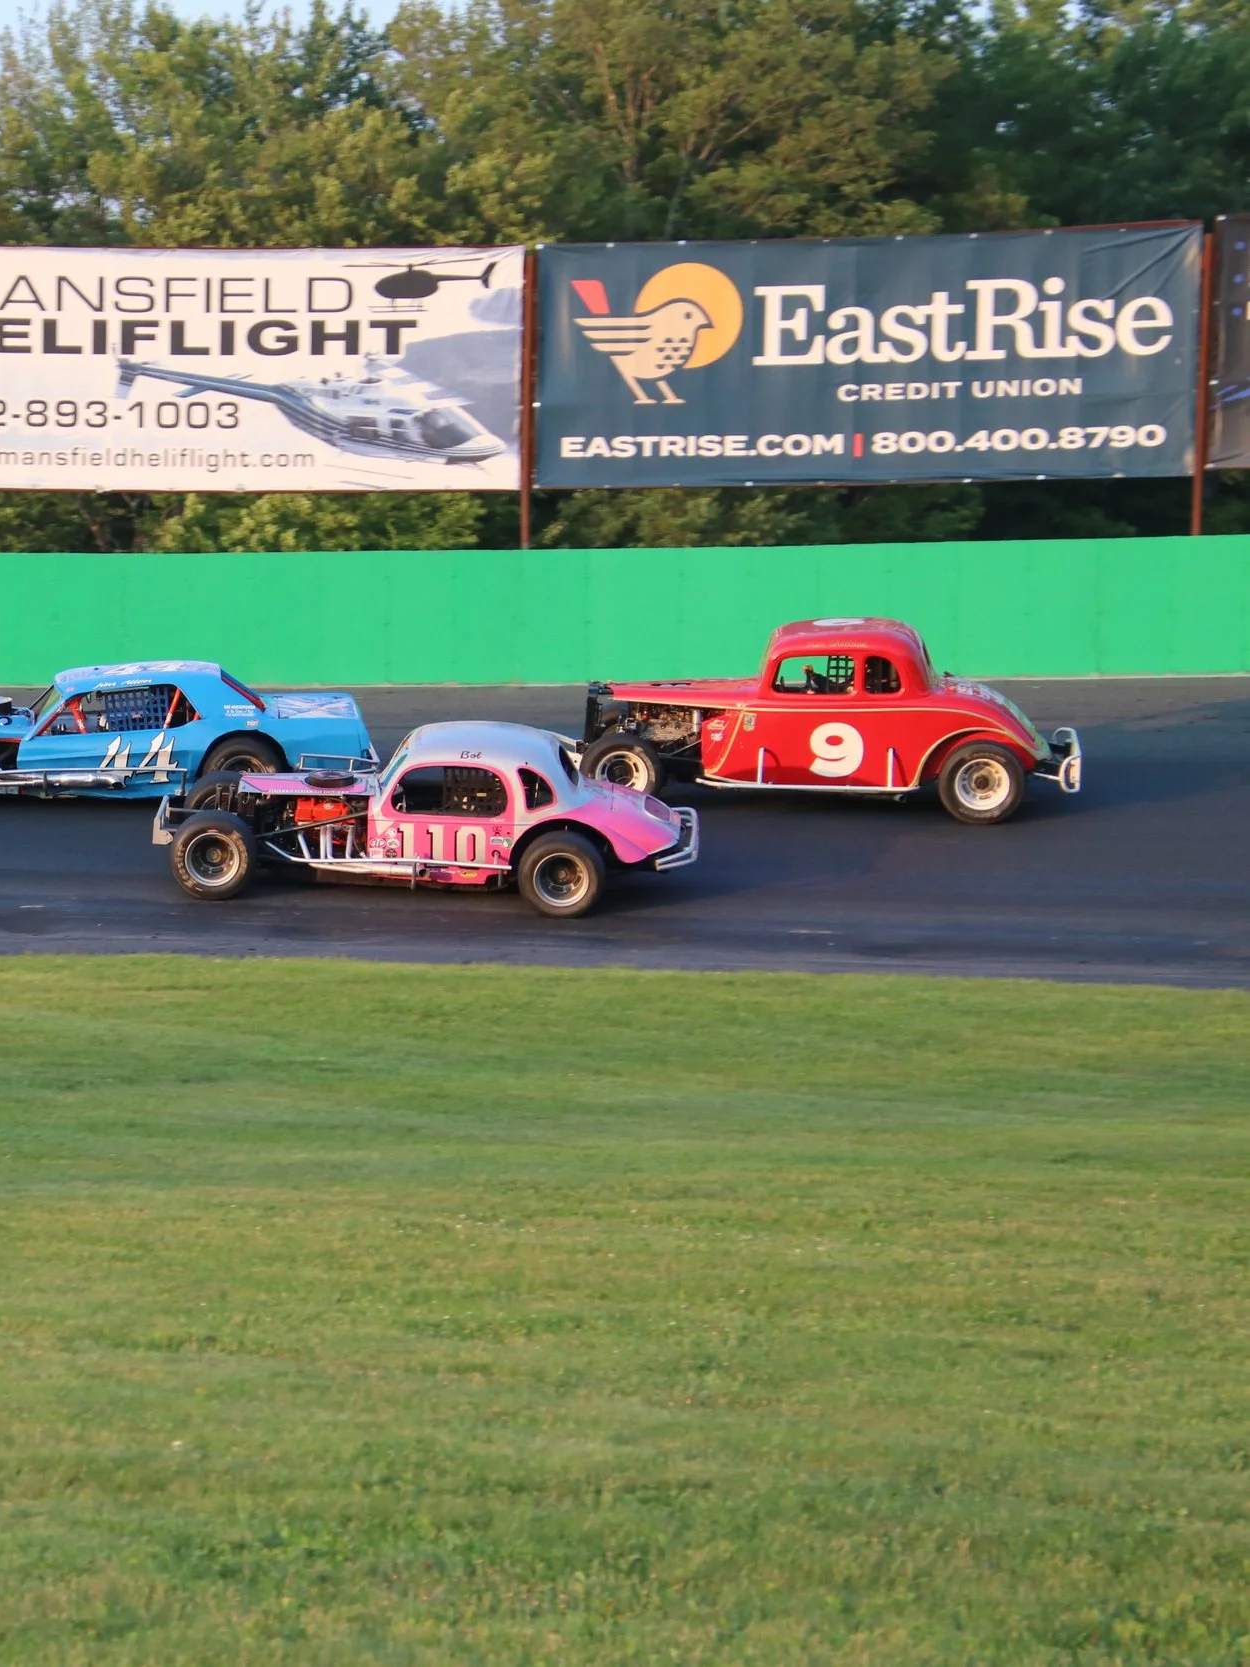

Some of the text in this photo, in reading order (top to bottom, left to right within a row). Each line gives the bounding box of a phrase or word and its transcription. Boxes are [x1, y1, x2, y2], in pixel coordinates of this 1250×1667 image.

[752, 276, 1173, 366] EastRise
[836, 377, 1083, 403] CREDIT UNION
[560, 424, 1167, 458] EASTRISE.COM 800.400.8790
[98, 730, 181, 788] 44
[809, 721, 865, 778] 9
[397, 822, 487, 869] 110
